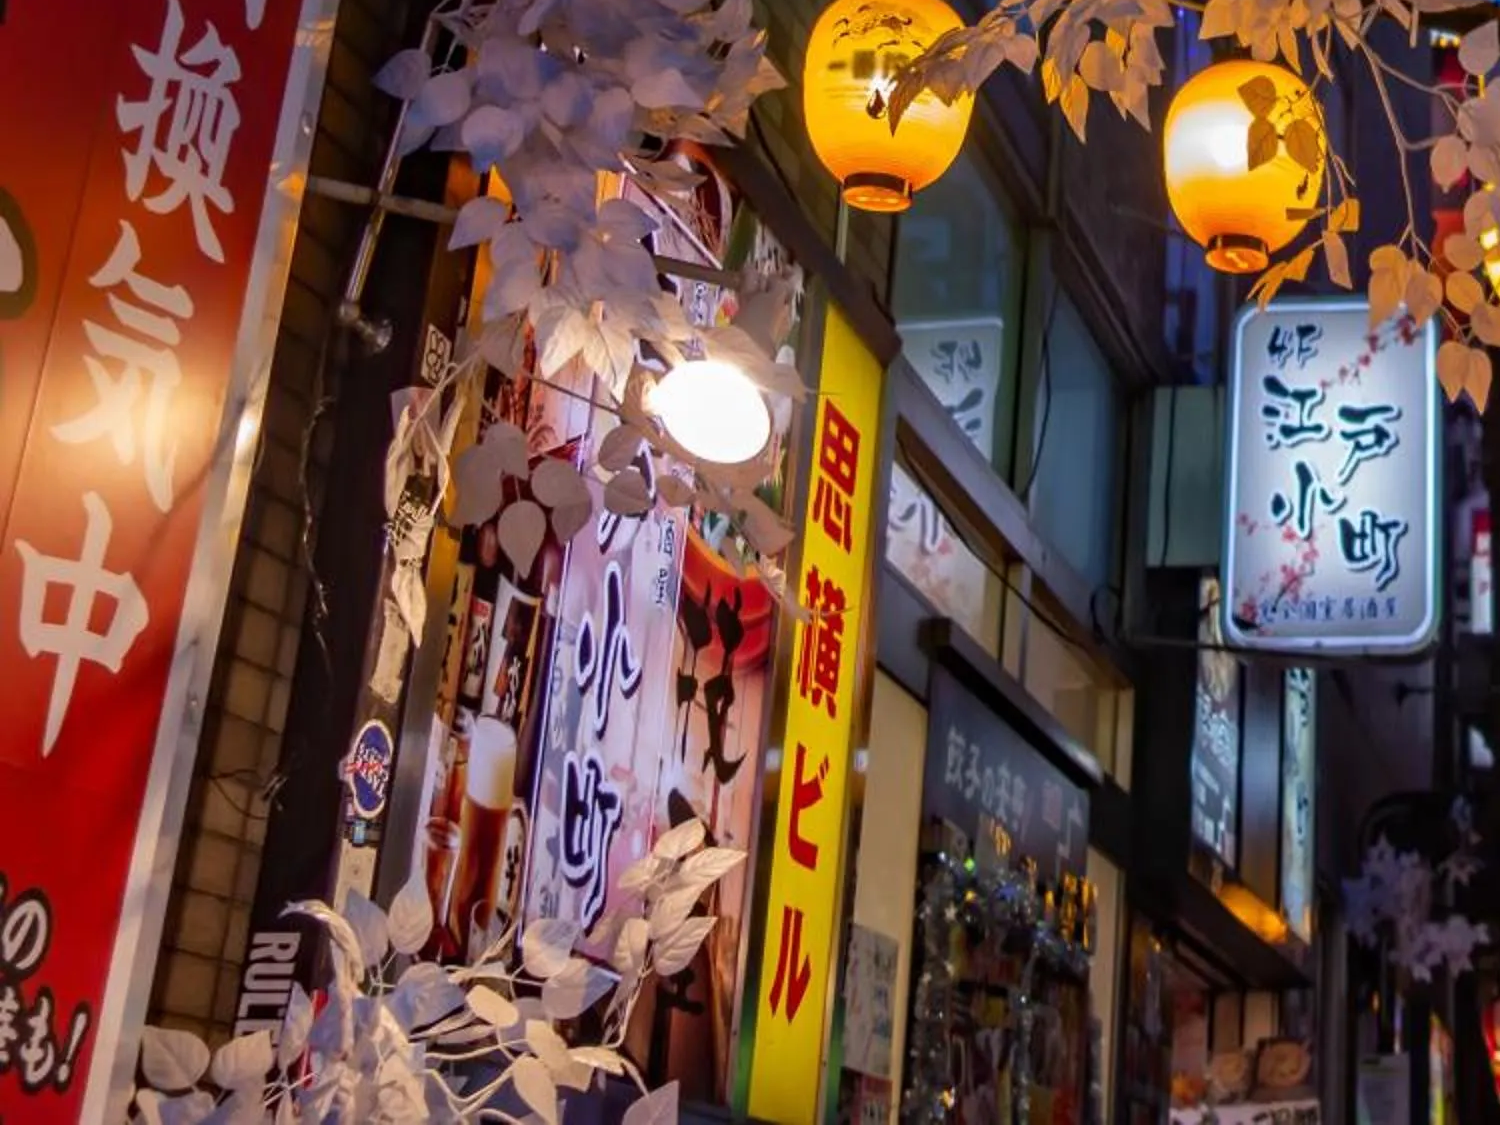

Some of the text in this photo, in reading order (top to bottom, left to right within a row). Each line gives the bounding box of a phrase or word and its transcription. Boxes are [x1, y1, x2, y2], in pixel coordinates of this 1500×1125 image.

[1261, 373, 1404, 587] 江戸小町
[769, 398, 861, 1025] 思横ビル
